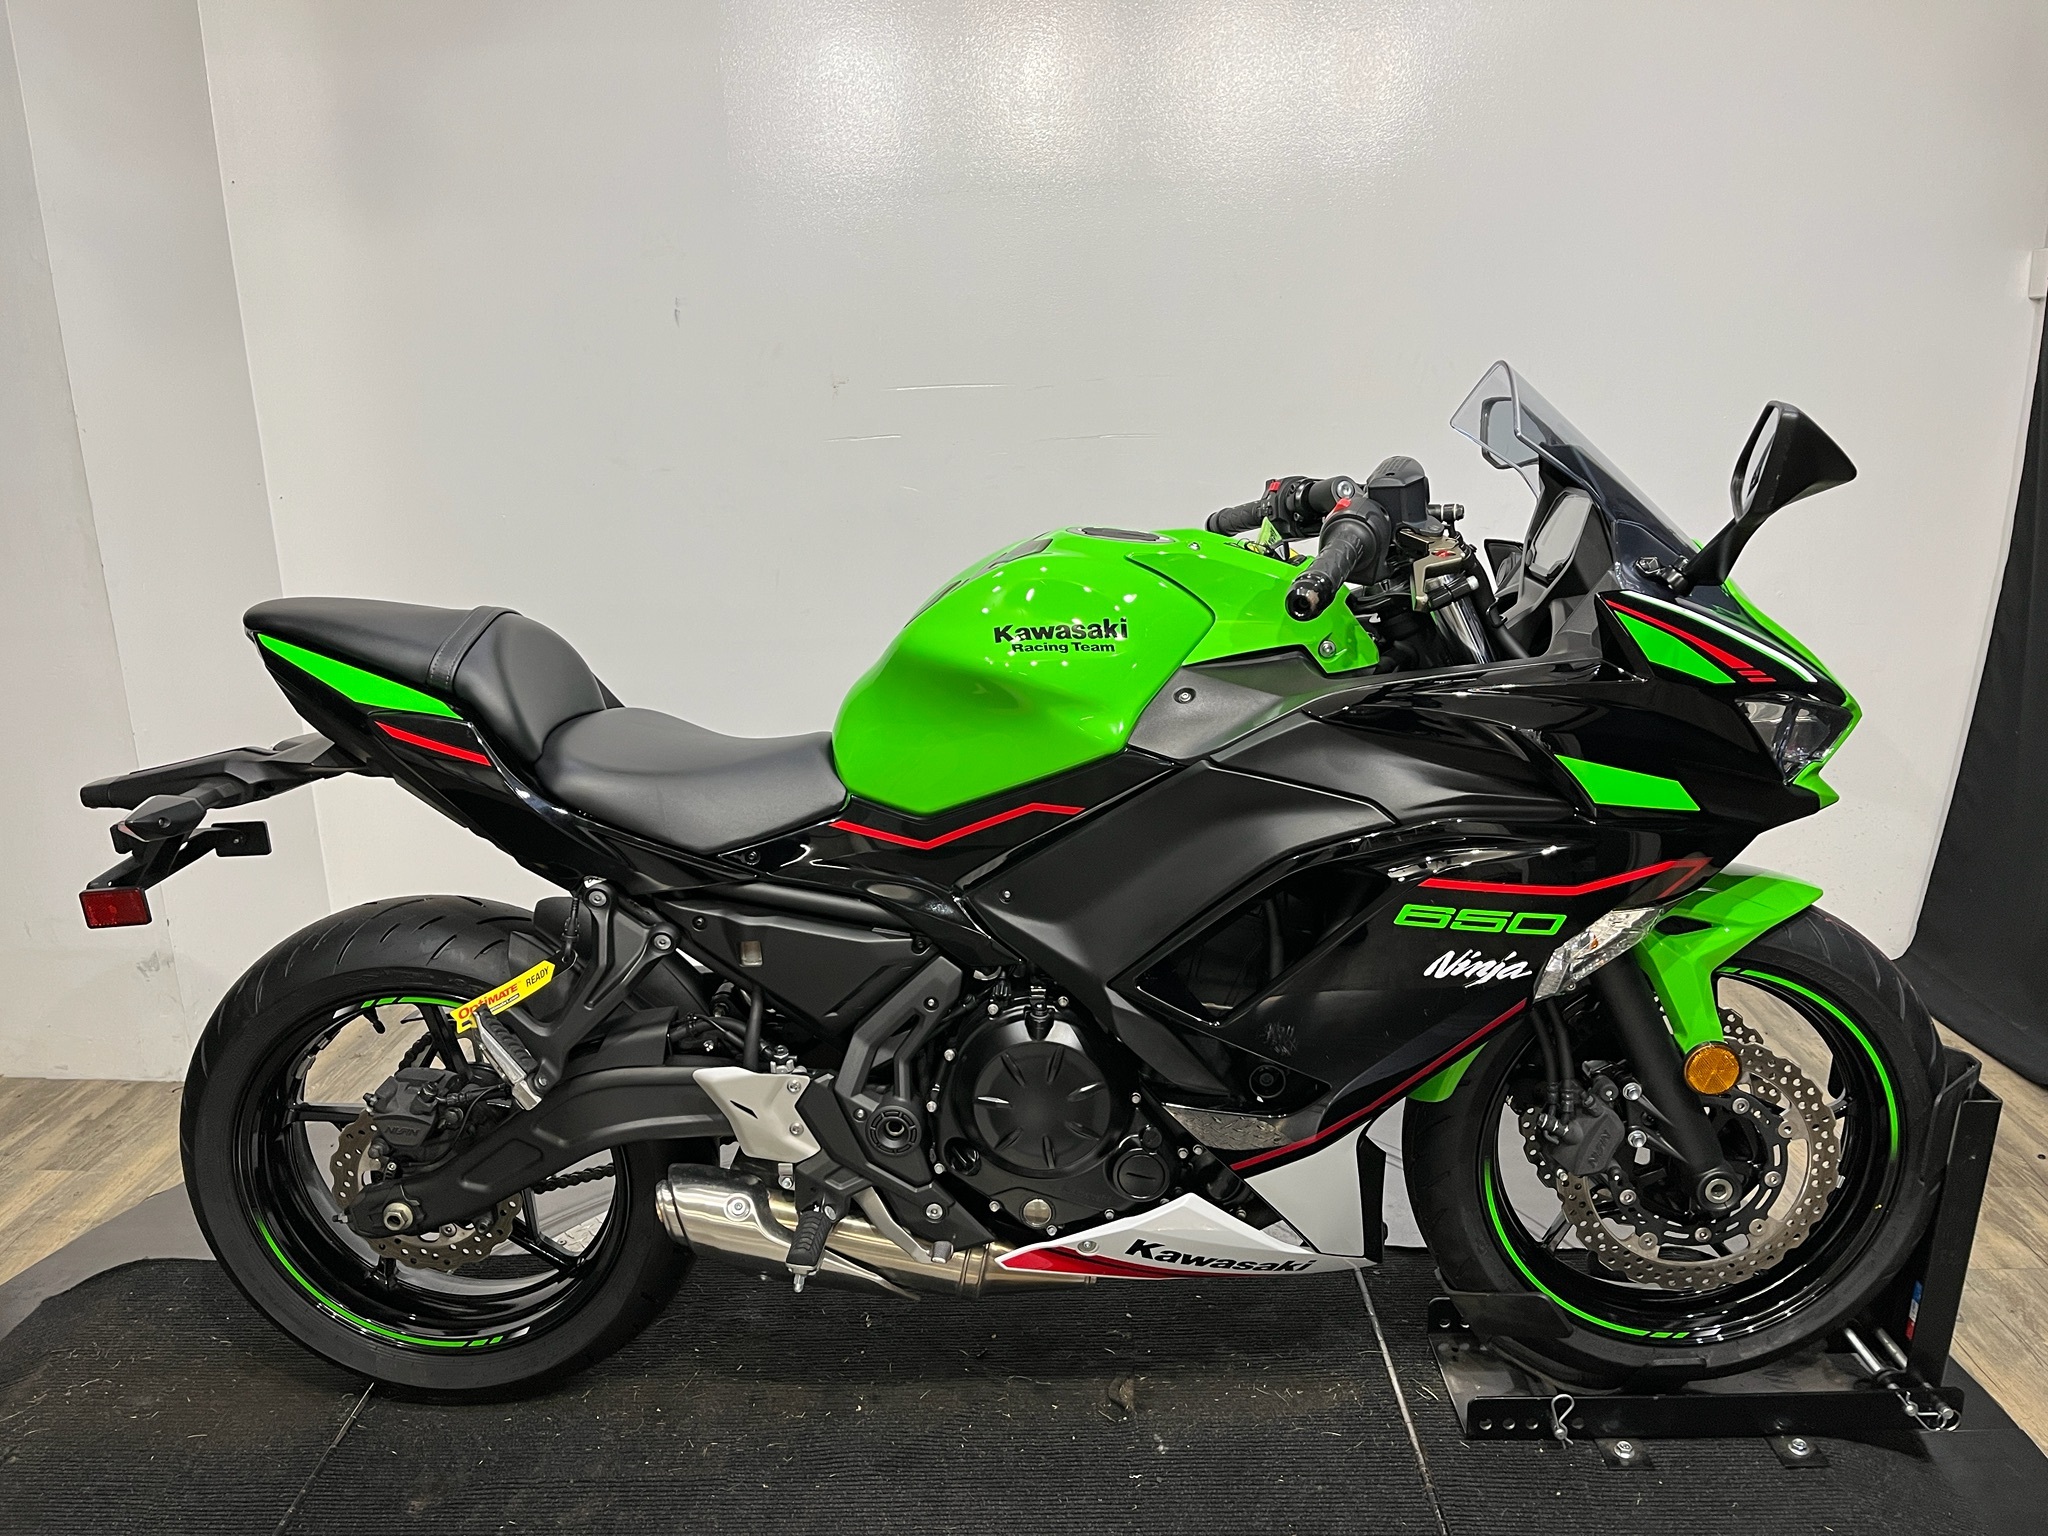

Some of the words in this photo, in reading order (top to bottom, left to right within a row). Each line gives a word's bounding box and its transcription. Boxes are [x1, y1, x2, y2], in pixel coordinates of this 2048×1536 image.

[994, 618, 1128, 643] Kawasaki
[1012, 643, 1069, 653] Racing
[1071, 642, 1115, 652] Team
[1394, 904, 1567, 935] 650
[525, 966, 549, 987] READY
[1423, 949, 1533, 989] Ninja
[1125, 1238, 1318, 1272] Kawasaki
